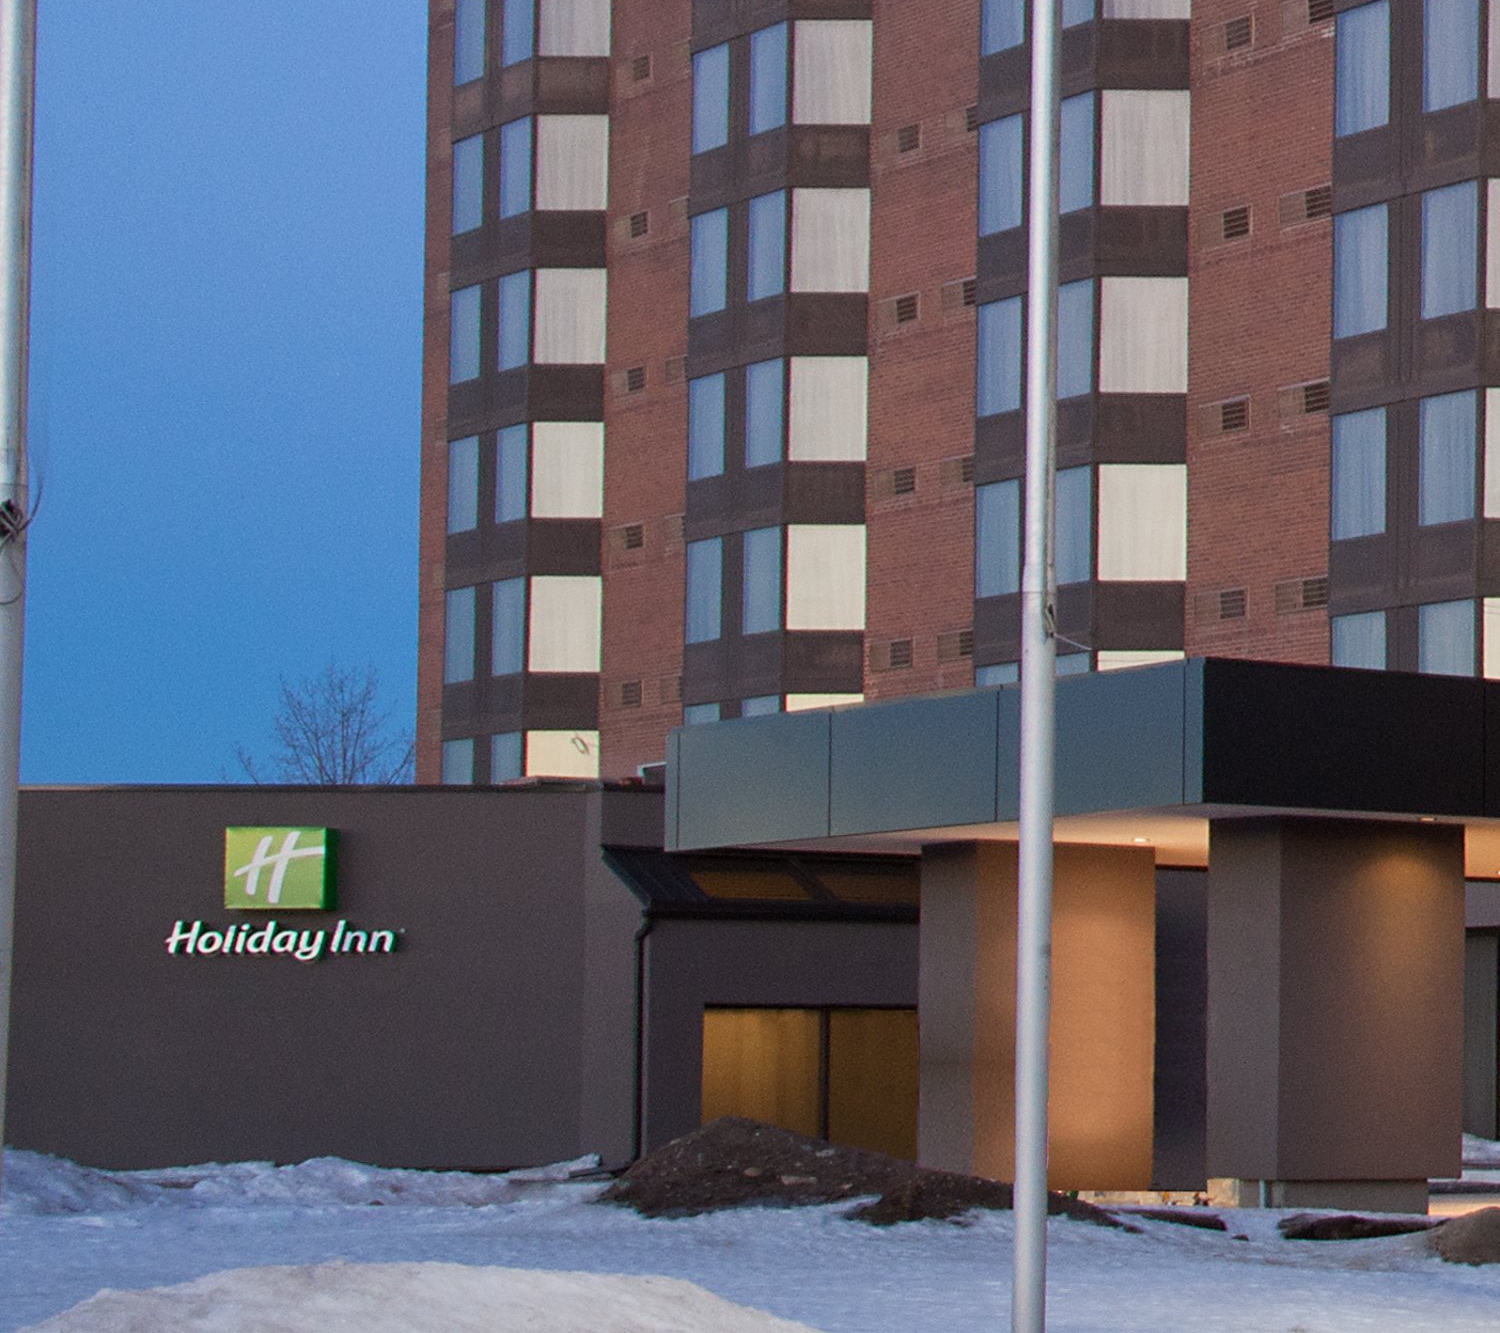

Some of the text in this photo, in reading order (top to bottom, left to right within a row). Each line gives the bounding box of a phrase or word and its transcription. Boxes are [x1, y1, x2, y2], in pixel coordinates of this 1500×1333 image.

[233, 831, 326, 904] H
[165, 919, 395, 961] Holiday Inn
